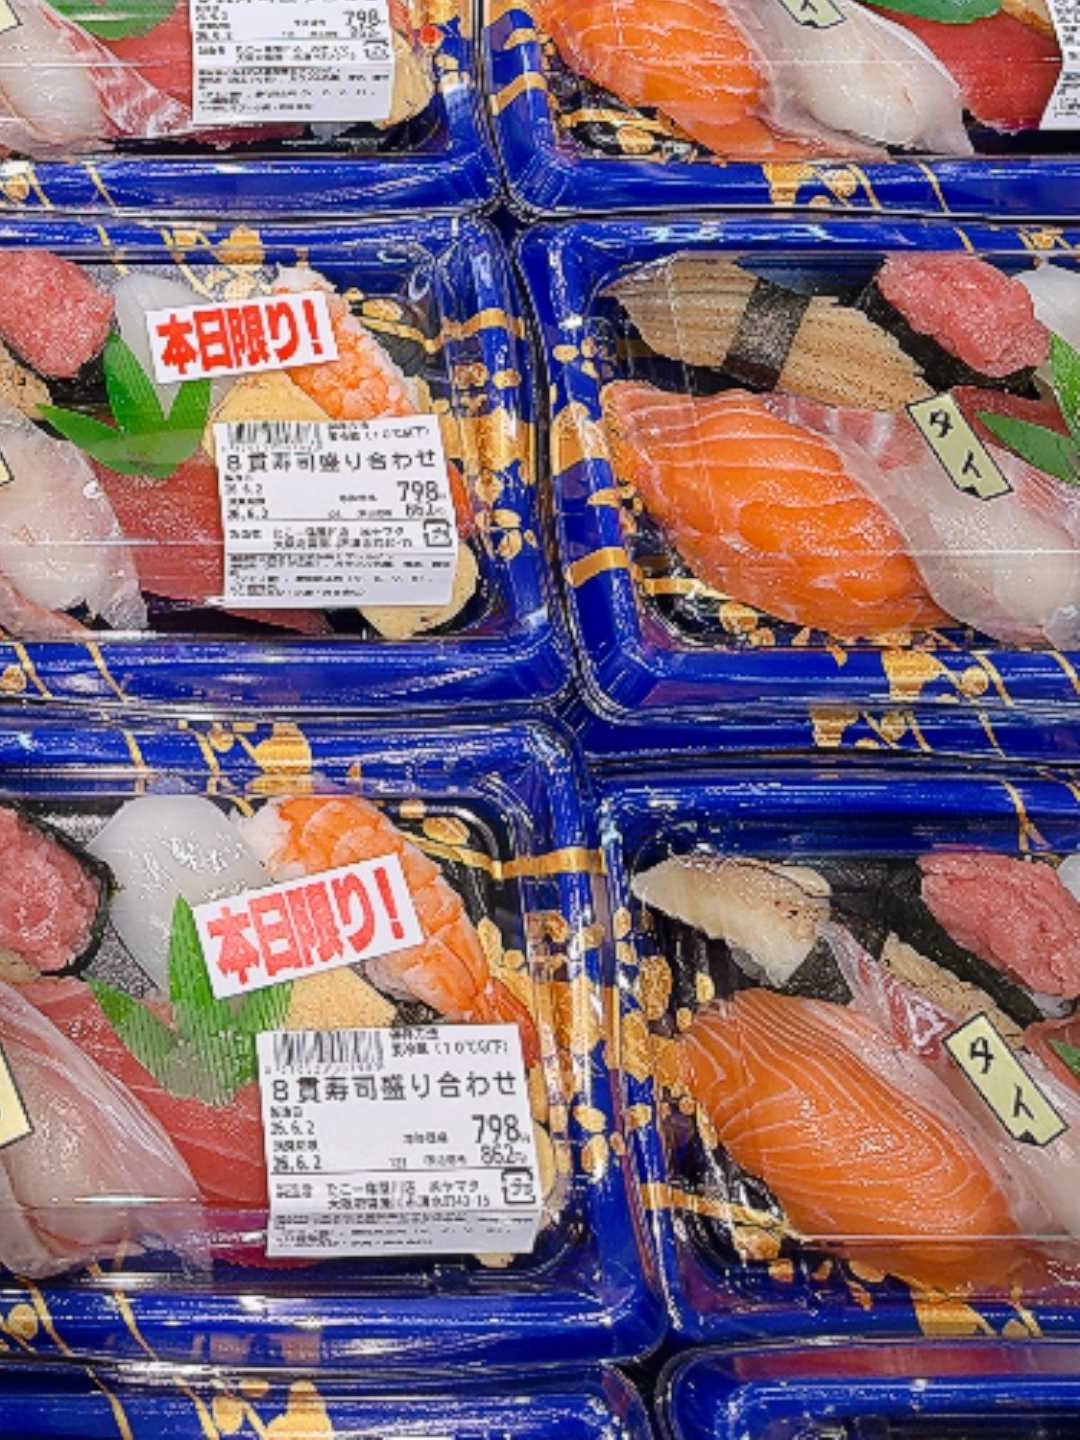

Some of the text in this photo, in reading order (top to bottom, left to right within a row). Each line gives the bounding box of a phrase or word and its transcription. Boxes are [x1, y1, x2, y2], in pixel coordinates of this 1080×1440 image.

[156, 299, 324, 376] 本日限り!
[226, 449, 436, 473] 8貫寿司盛り合わせ
[928, 408, 983, 480] タイ
[206, 865, 404, 985] 本日限り!
[272, 1071, 517, 1104] 8貫寿司盛り合わせ
[969, 1035, 1035, 1121] タイ
